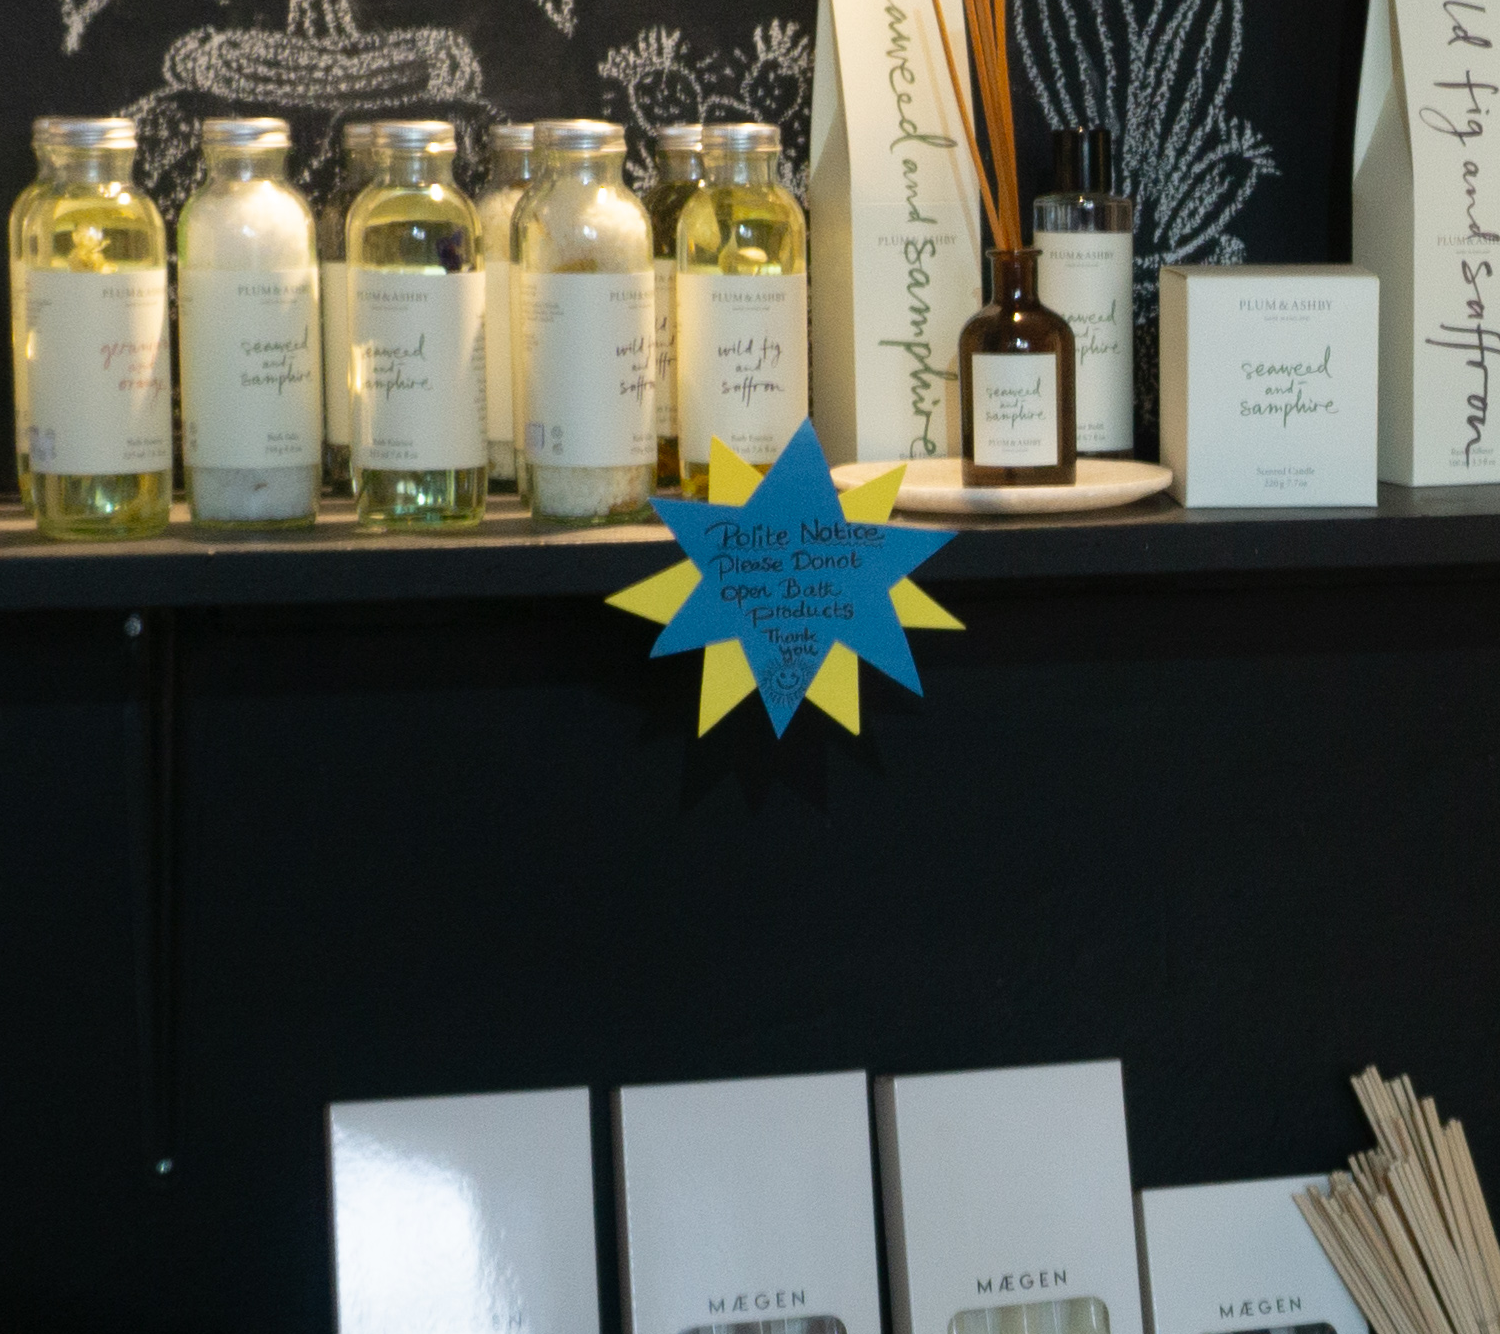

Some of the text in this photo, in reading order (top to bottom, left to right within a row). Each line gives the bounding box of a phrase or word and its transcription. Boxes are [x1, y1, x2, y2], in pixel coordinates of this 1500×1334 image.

[1418, 69, 1499, 148] fig
[1461, 160, 1500, 242] and
[901, 157, 938, 225] and
[1238, 300, 1334, 311] PLUM & ASHBY
[719, 336, 782, 367] wild fig
[877, 237, 959, 458] samphire
[736, 359, 762, 372] and
[1241, 345, 1332, 379] seaweed
[721, 376, 784, 407] saffron
[986, 377, 1042, 401] seaweed
[1265, 379, 1293, 395] and
[986, 407, 1047, 429] samphire
[1240, 389, 1339, 428] samphire
[704, 519, 886, 548] Polite Notice
[708, 554, 784, 581] Please
[720, 577, 841, 608] open Bath
[761, 628, 818, 643] Thank
[976, 1269, 1068, 1295] MÆGEN
[708, 1289, 807, 1314] MÆGEN
[1218, 1296, 1302, 1319] MÆGEN
